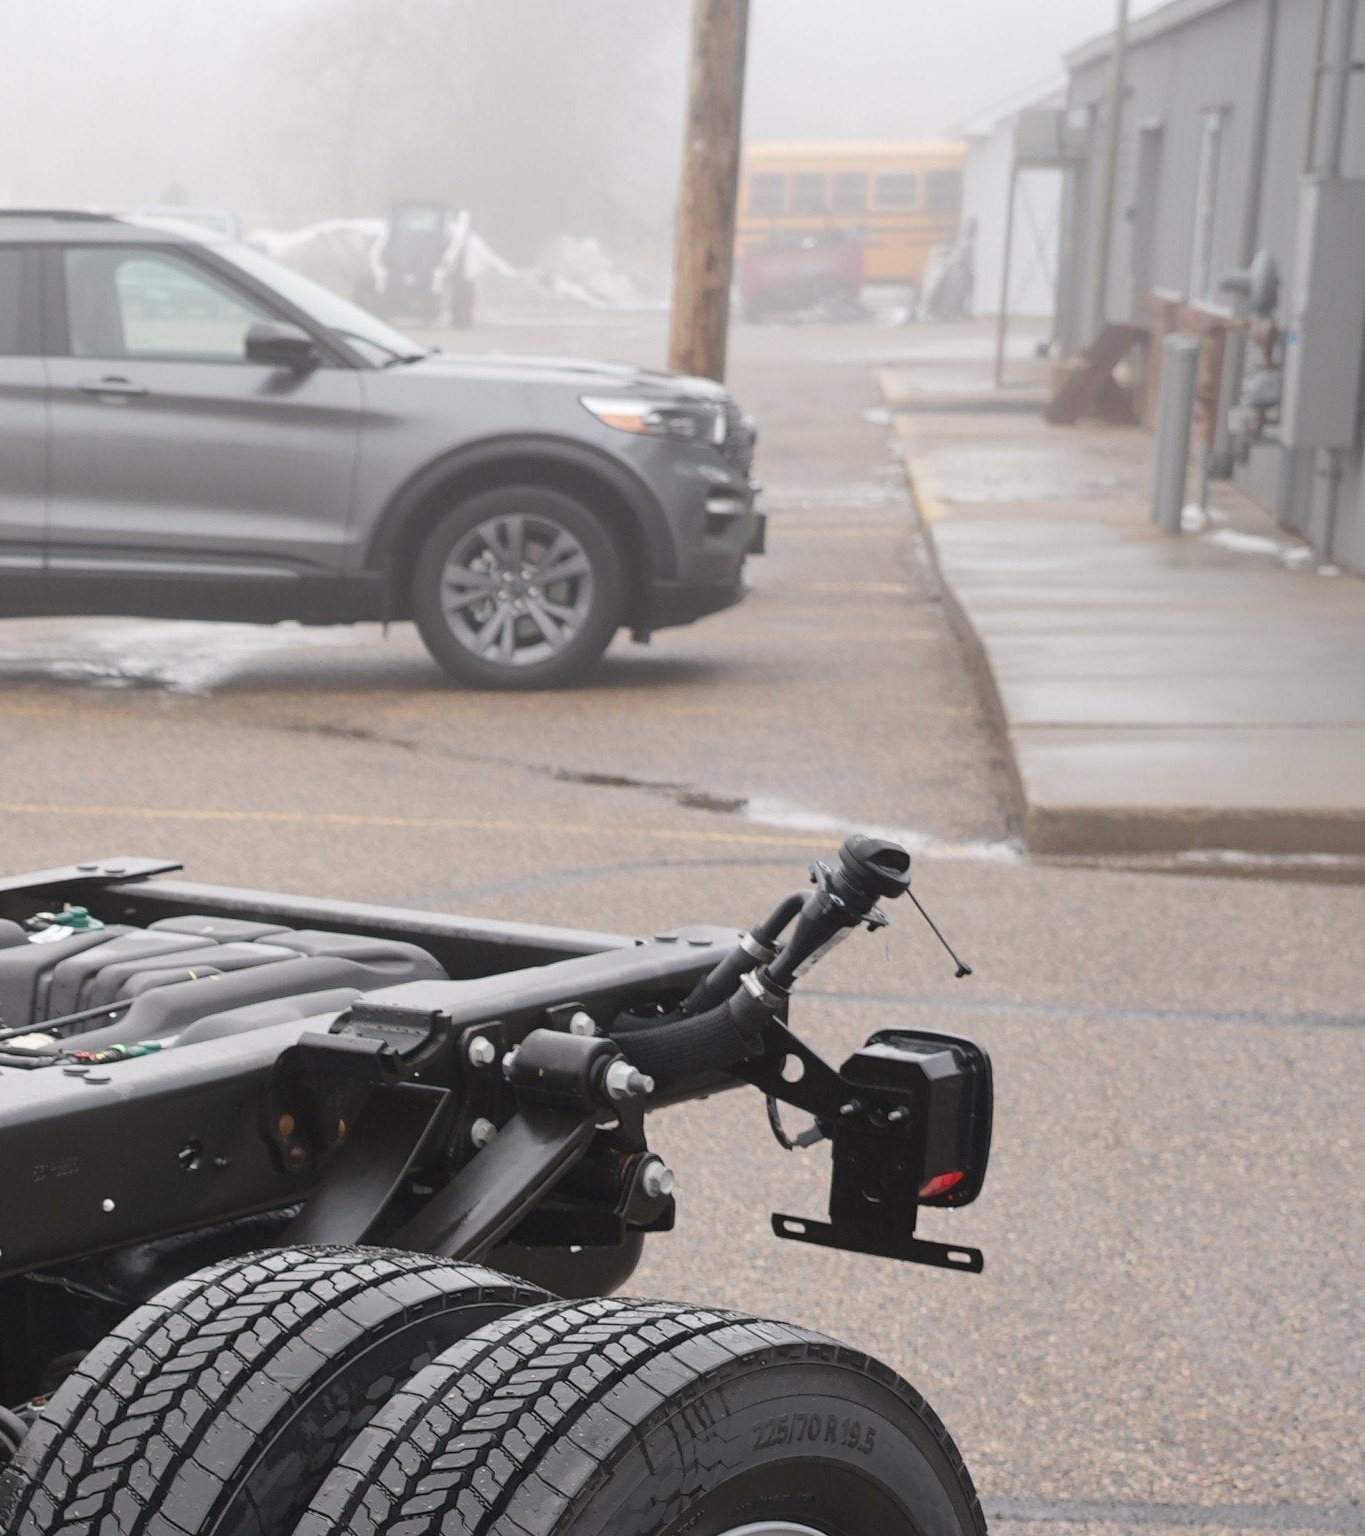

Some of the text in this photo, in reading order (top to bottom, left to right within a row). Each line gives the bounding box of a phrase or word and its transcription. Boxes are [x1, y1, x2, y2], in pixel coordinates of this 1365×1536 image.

[751, 1412, 877, 1455] 225/70 R 19.5
